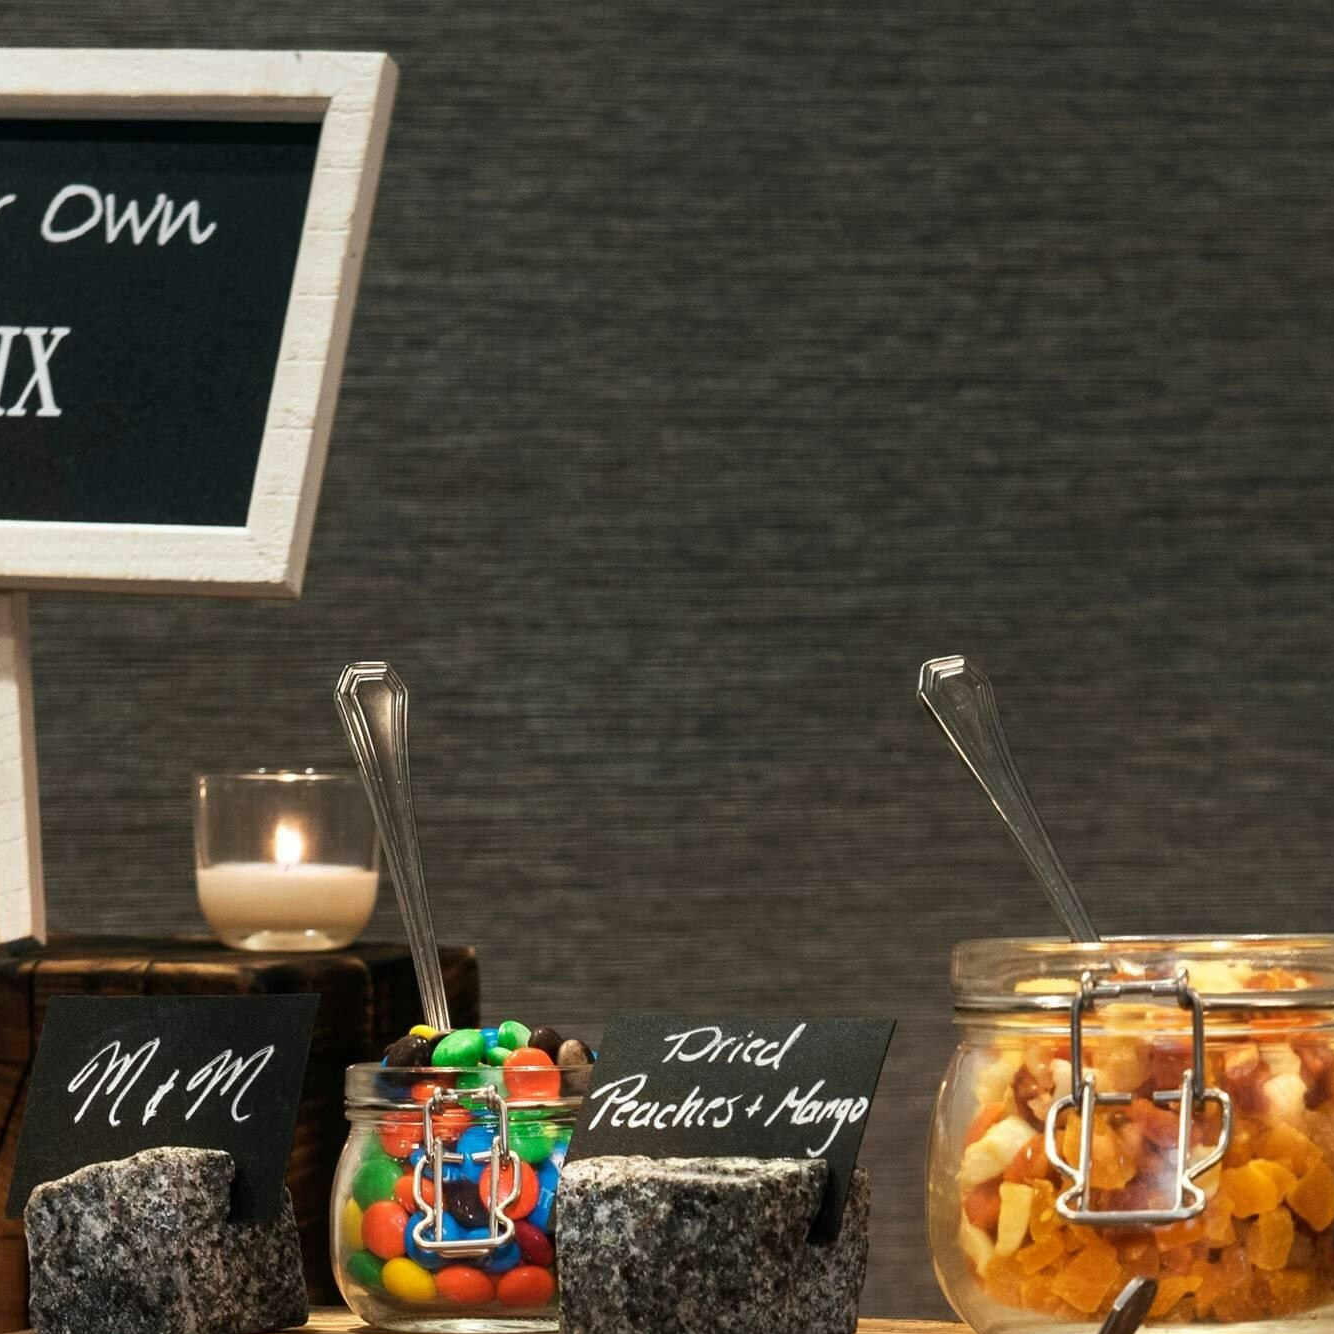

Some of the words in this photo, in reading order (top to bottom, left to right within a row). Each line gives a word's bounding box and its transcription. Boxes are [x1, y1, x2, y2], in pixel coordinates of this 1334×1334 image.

[40, 183, 217, 245] Own
[67, 1037, 161, 1127] M
[185, 1045, 275, 1122] M
[662, 1023, 807, 1070] Dried
[588, 1074, 743, 1131] Peaches
[745, 1094, 764, 1119] +
[763, 1079, 869, 1158] Mango
